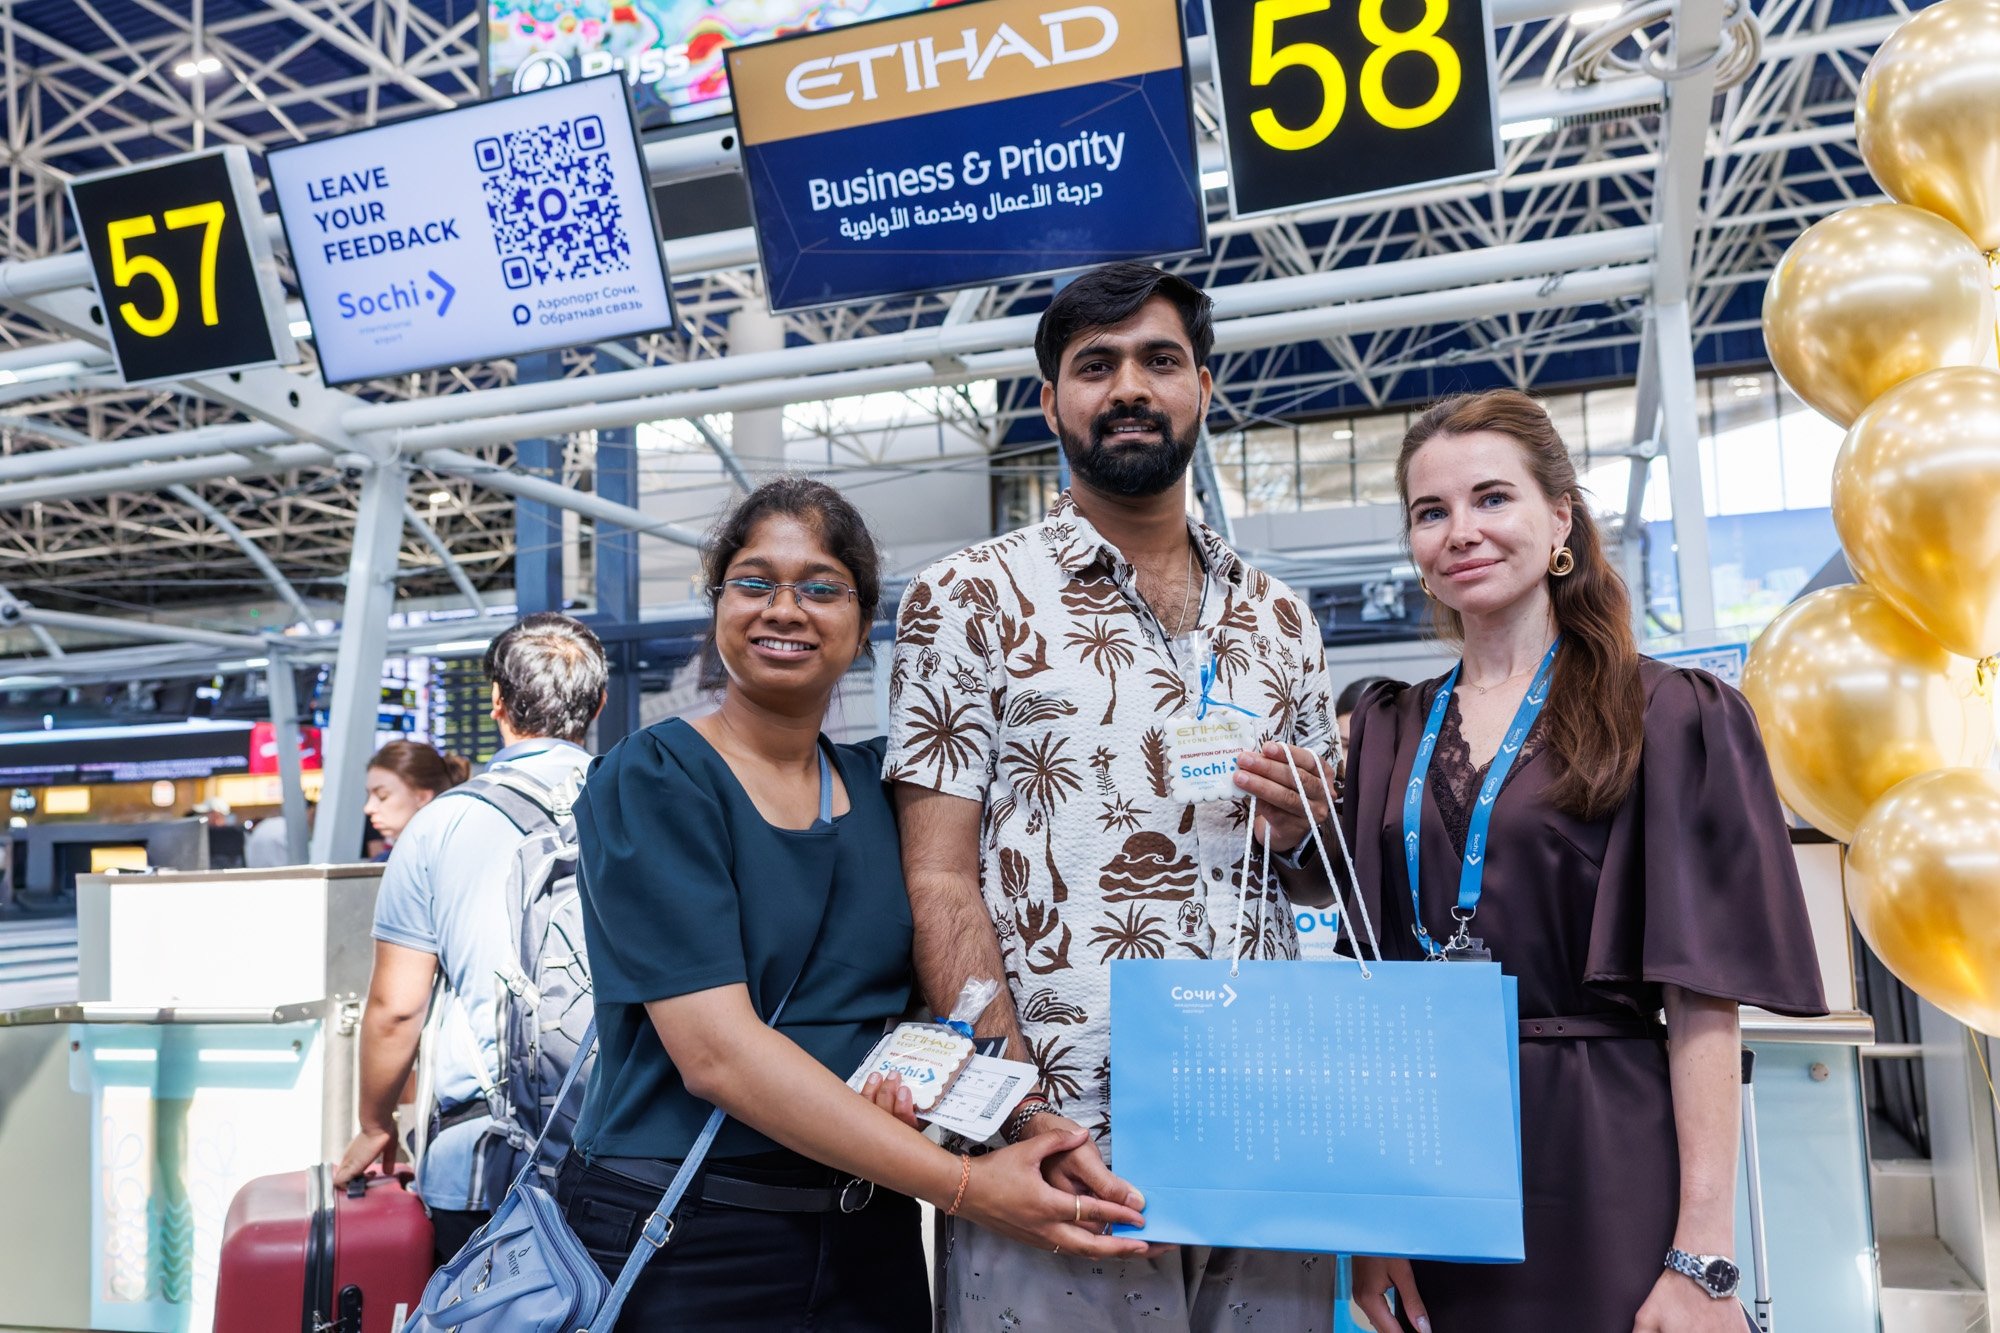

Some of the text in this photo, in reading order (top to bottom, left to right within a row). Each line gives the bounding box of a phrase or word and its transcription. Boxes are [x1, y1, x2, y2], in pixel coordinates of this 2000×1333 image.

[785, 5, 1119, 110] ETIHAD
[1250, 0, 1461, 150] 58
[307, 167, 389, 204] LEAVE
[809, 131, 1125, 211] Business & Priority
[315, 201, 386, 233] YOUR
[840, 182, 1103, 240] درجة الأعمال وخدمة الأولوية
[324, 218, 460, 265] FEEDBACK
[107, 201, 225, 337] 57
[338, 280, 420, 319] Sochi
[537, 290, 601, 310] Аэропорт
[539, 301, 643, 327] Обратная связь
[1176, 722, 1240, 737] ETIHAD
[1182, 762, 1226, 778] Sochi
[1472, 833, 1481, 852] Sochi
[1171, 986, 1216, 1000] Сочи
[902, 1032, 957, 1050] ETIHAD
